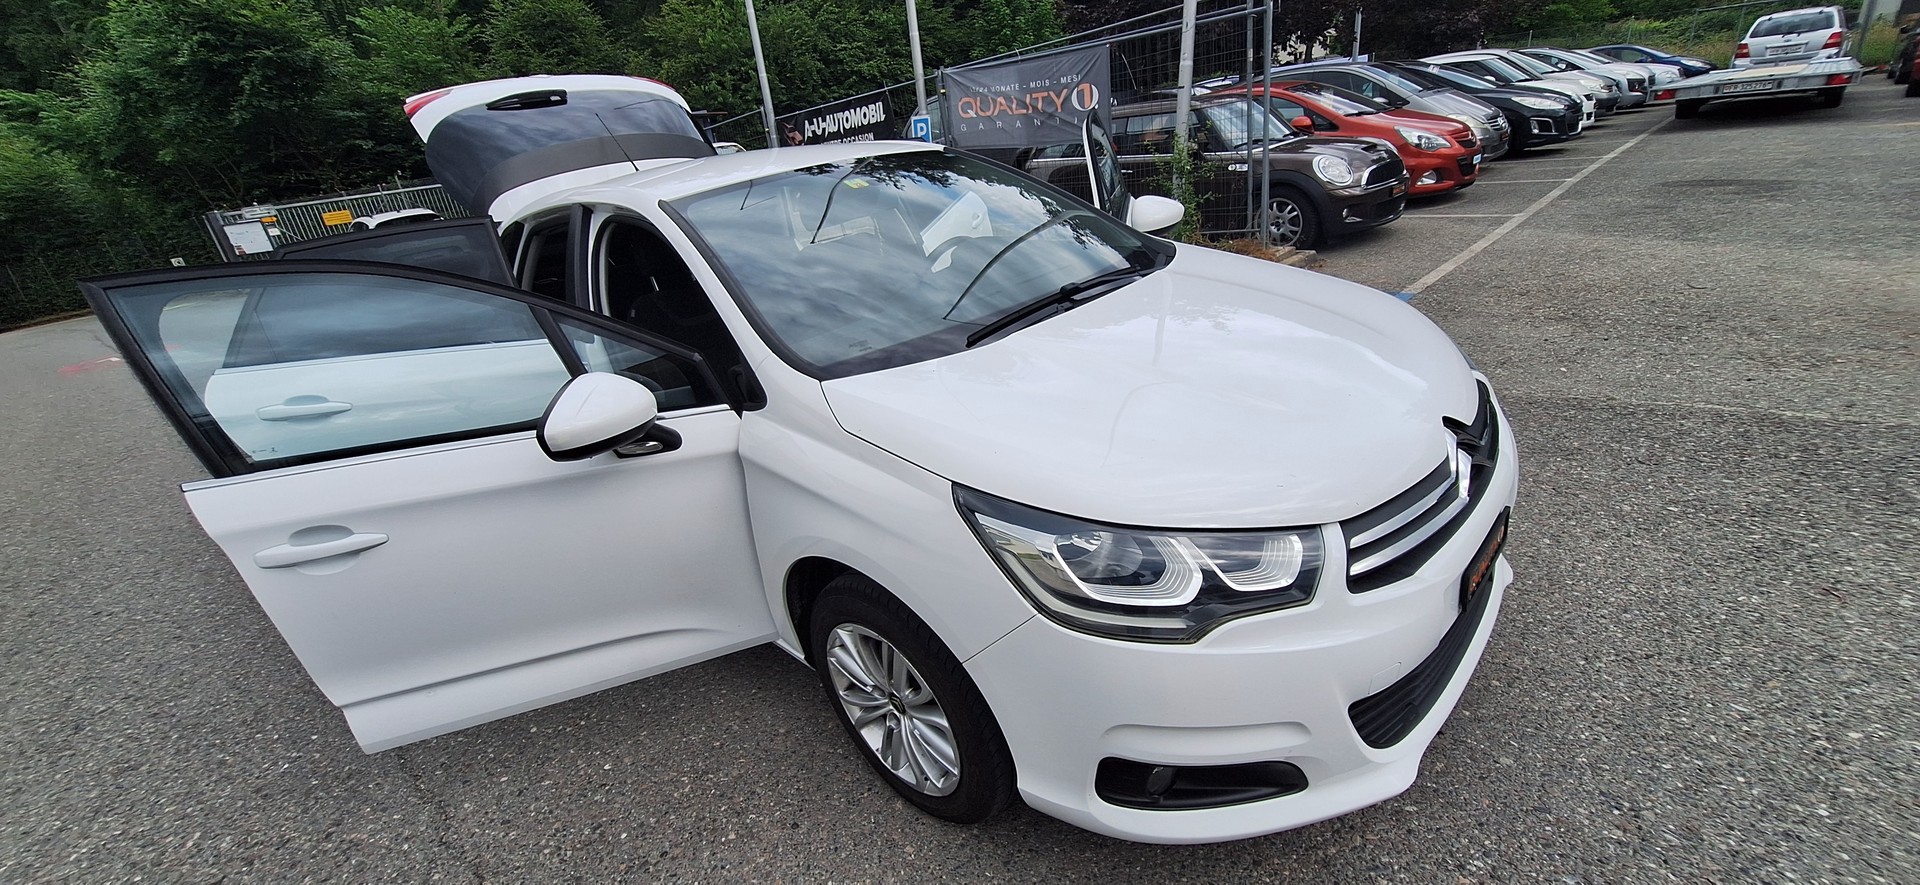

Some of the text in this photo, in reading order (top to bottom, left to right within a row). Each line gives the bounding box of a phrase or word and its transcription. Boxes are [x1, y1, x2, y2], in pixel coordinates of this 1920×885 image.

[1030, 80, 1050, 89] MOIS
[1060, 75, 1081, 84] MESI
[958, 88, 1068, 118] QUALITY
[804, 102, 885, 142] A-U-AUTOMOBIL
[960, 116, 1079, 131] GARANTI
[917, 123, 927, 138] P
